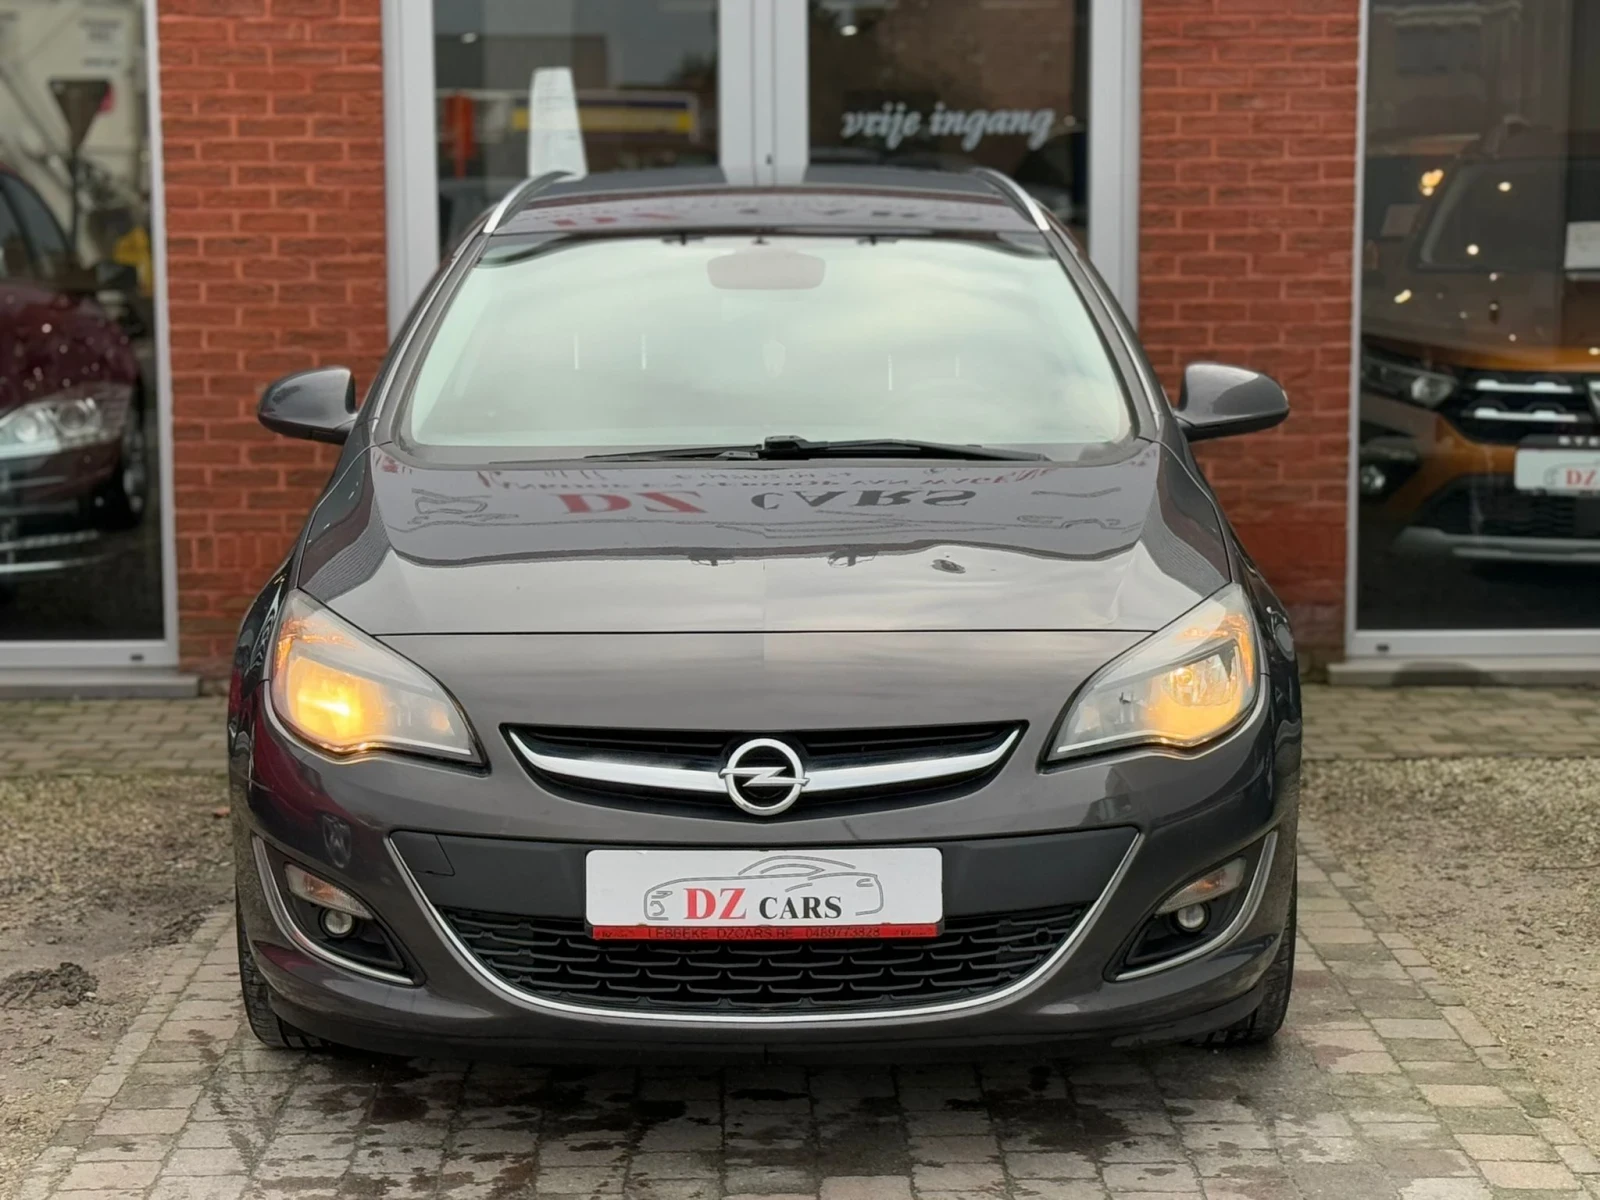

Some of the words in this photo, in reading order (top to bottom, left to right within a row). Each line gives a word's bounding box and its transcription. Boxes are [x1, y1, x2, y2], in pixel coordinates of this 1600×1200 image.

[841, 101, 921, 150] vrije
[929, 101, 1055, 150] ingang
[683, 887, 747, 920] DZ
[759, 896, 842, 920] CARS
